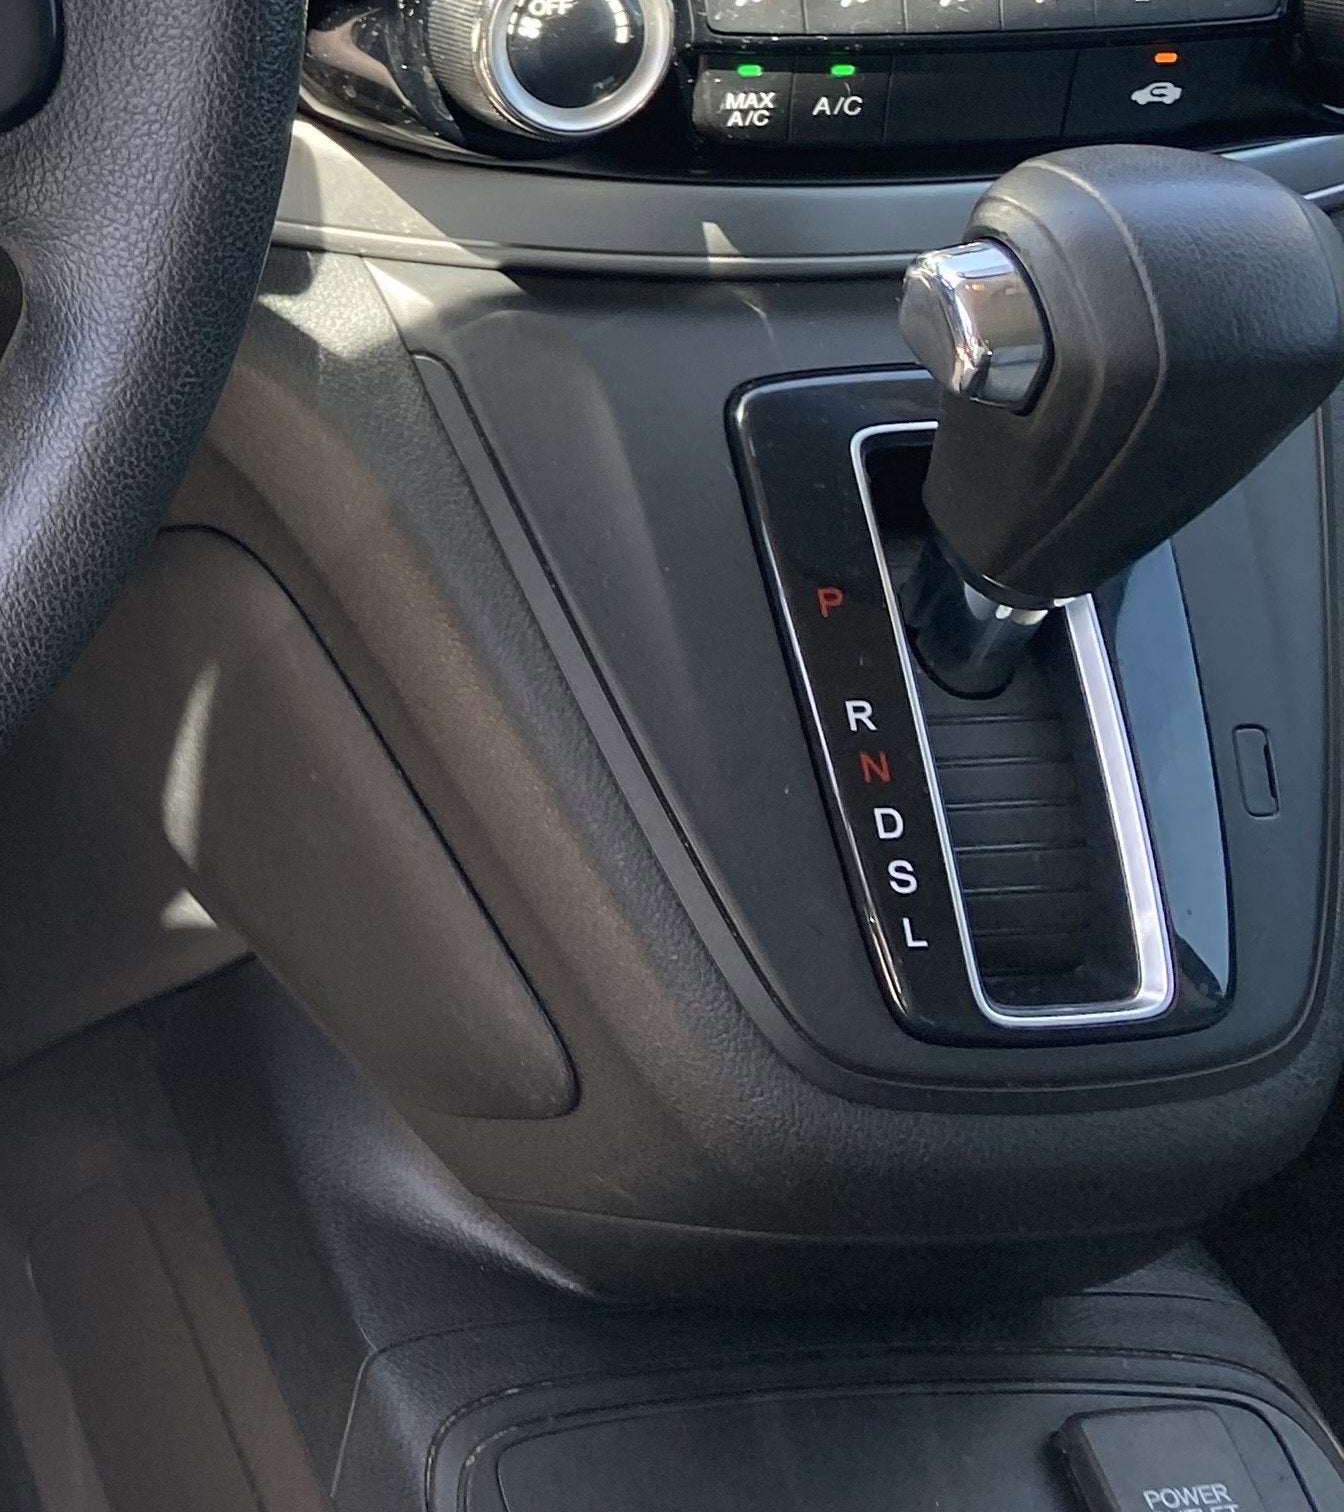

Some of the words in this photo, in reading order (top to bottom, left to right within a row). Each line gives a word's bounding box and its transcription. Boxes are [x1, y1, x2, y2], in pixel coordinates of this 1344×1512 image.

[725, 92, 776, 110] MAX
[812, 95, 863, 116] A/C
[726, 109, 771, 127] A/C
[817, 587, 845, 618] P
[845, 699, 877, 732] R
[859, 751, 891, 783] N
[873, 807, 904, 840] D
[888, 860, 918, 894] S
[902, 917, 928, 948] L
[1143, 1483, 1232, 1510] POWER
